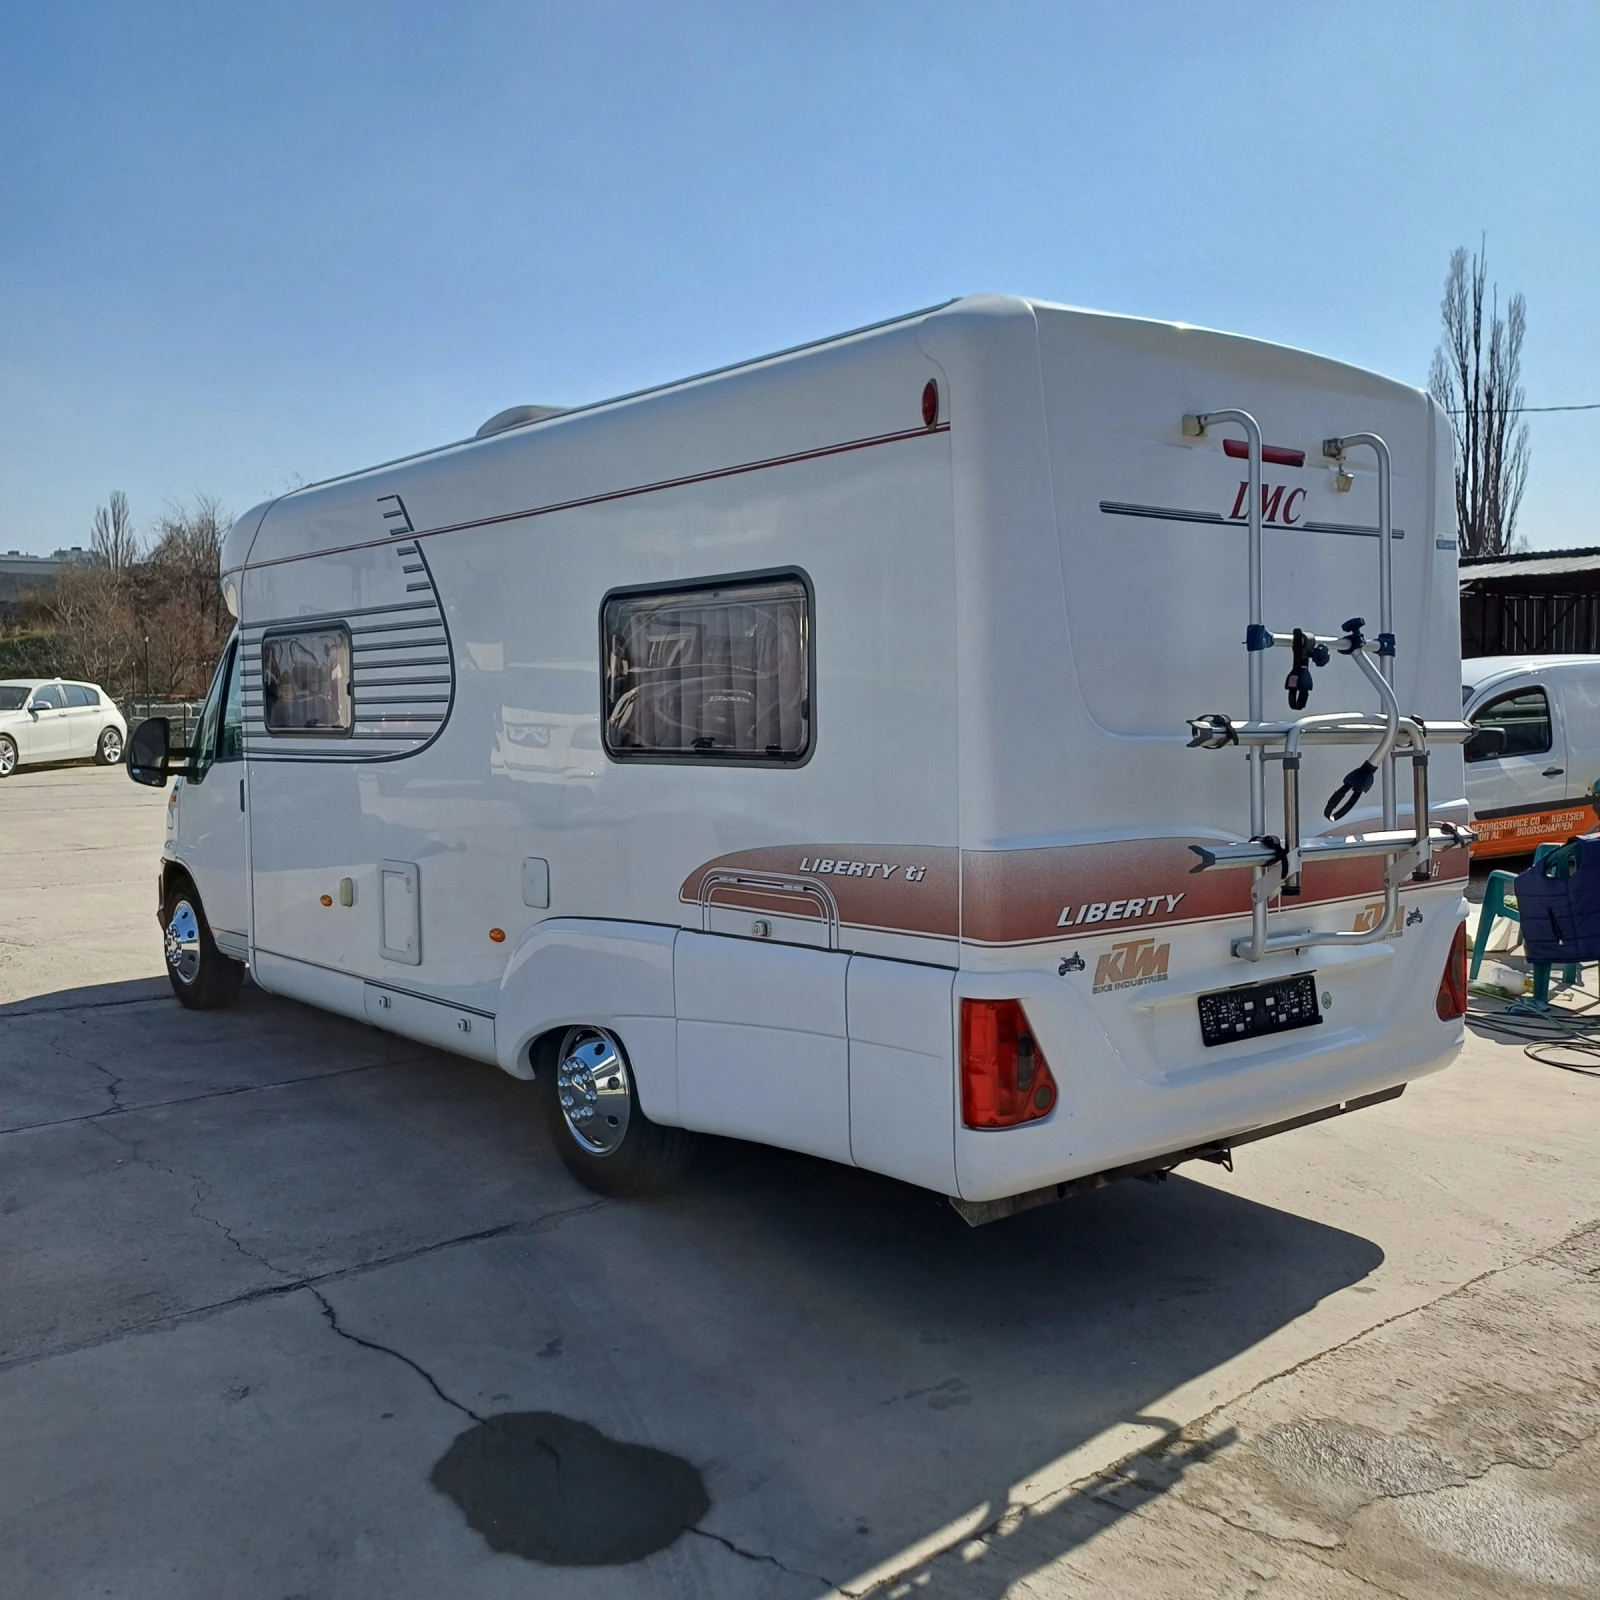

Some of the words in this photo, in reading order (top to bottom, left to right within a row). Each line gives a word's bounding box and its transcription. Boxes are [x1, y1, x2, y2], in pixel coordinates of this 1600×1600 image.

[1228, 481, 1307, 524] LMC
[1471, 817, 1528, 833] BEZORGSERVICE
[1551, 811, 1585, 823] KOETSIER
[1491, 830, 1501, 840] AL
[1516, 822, 1573, 836] BOODSCHAPPEN
[799, 857, 900, 880] LIBERTY
[905, 865, 927, 882] ti
[1056, 892, 1187, 928] LIBERTY
[1093, 937, 1171, 987] KTM
[1092, 983, 1113, 995] BIKE
[1114, 973, 1169, 991] INDUSTRIES
